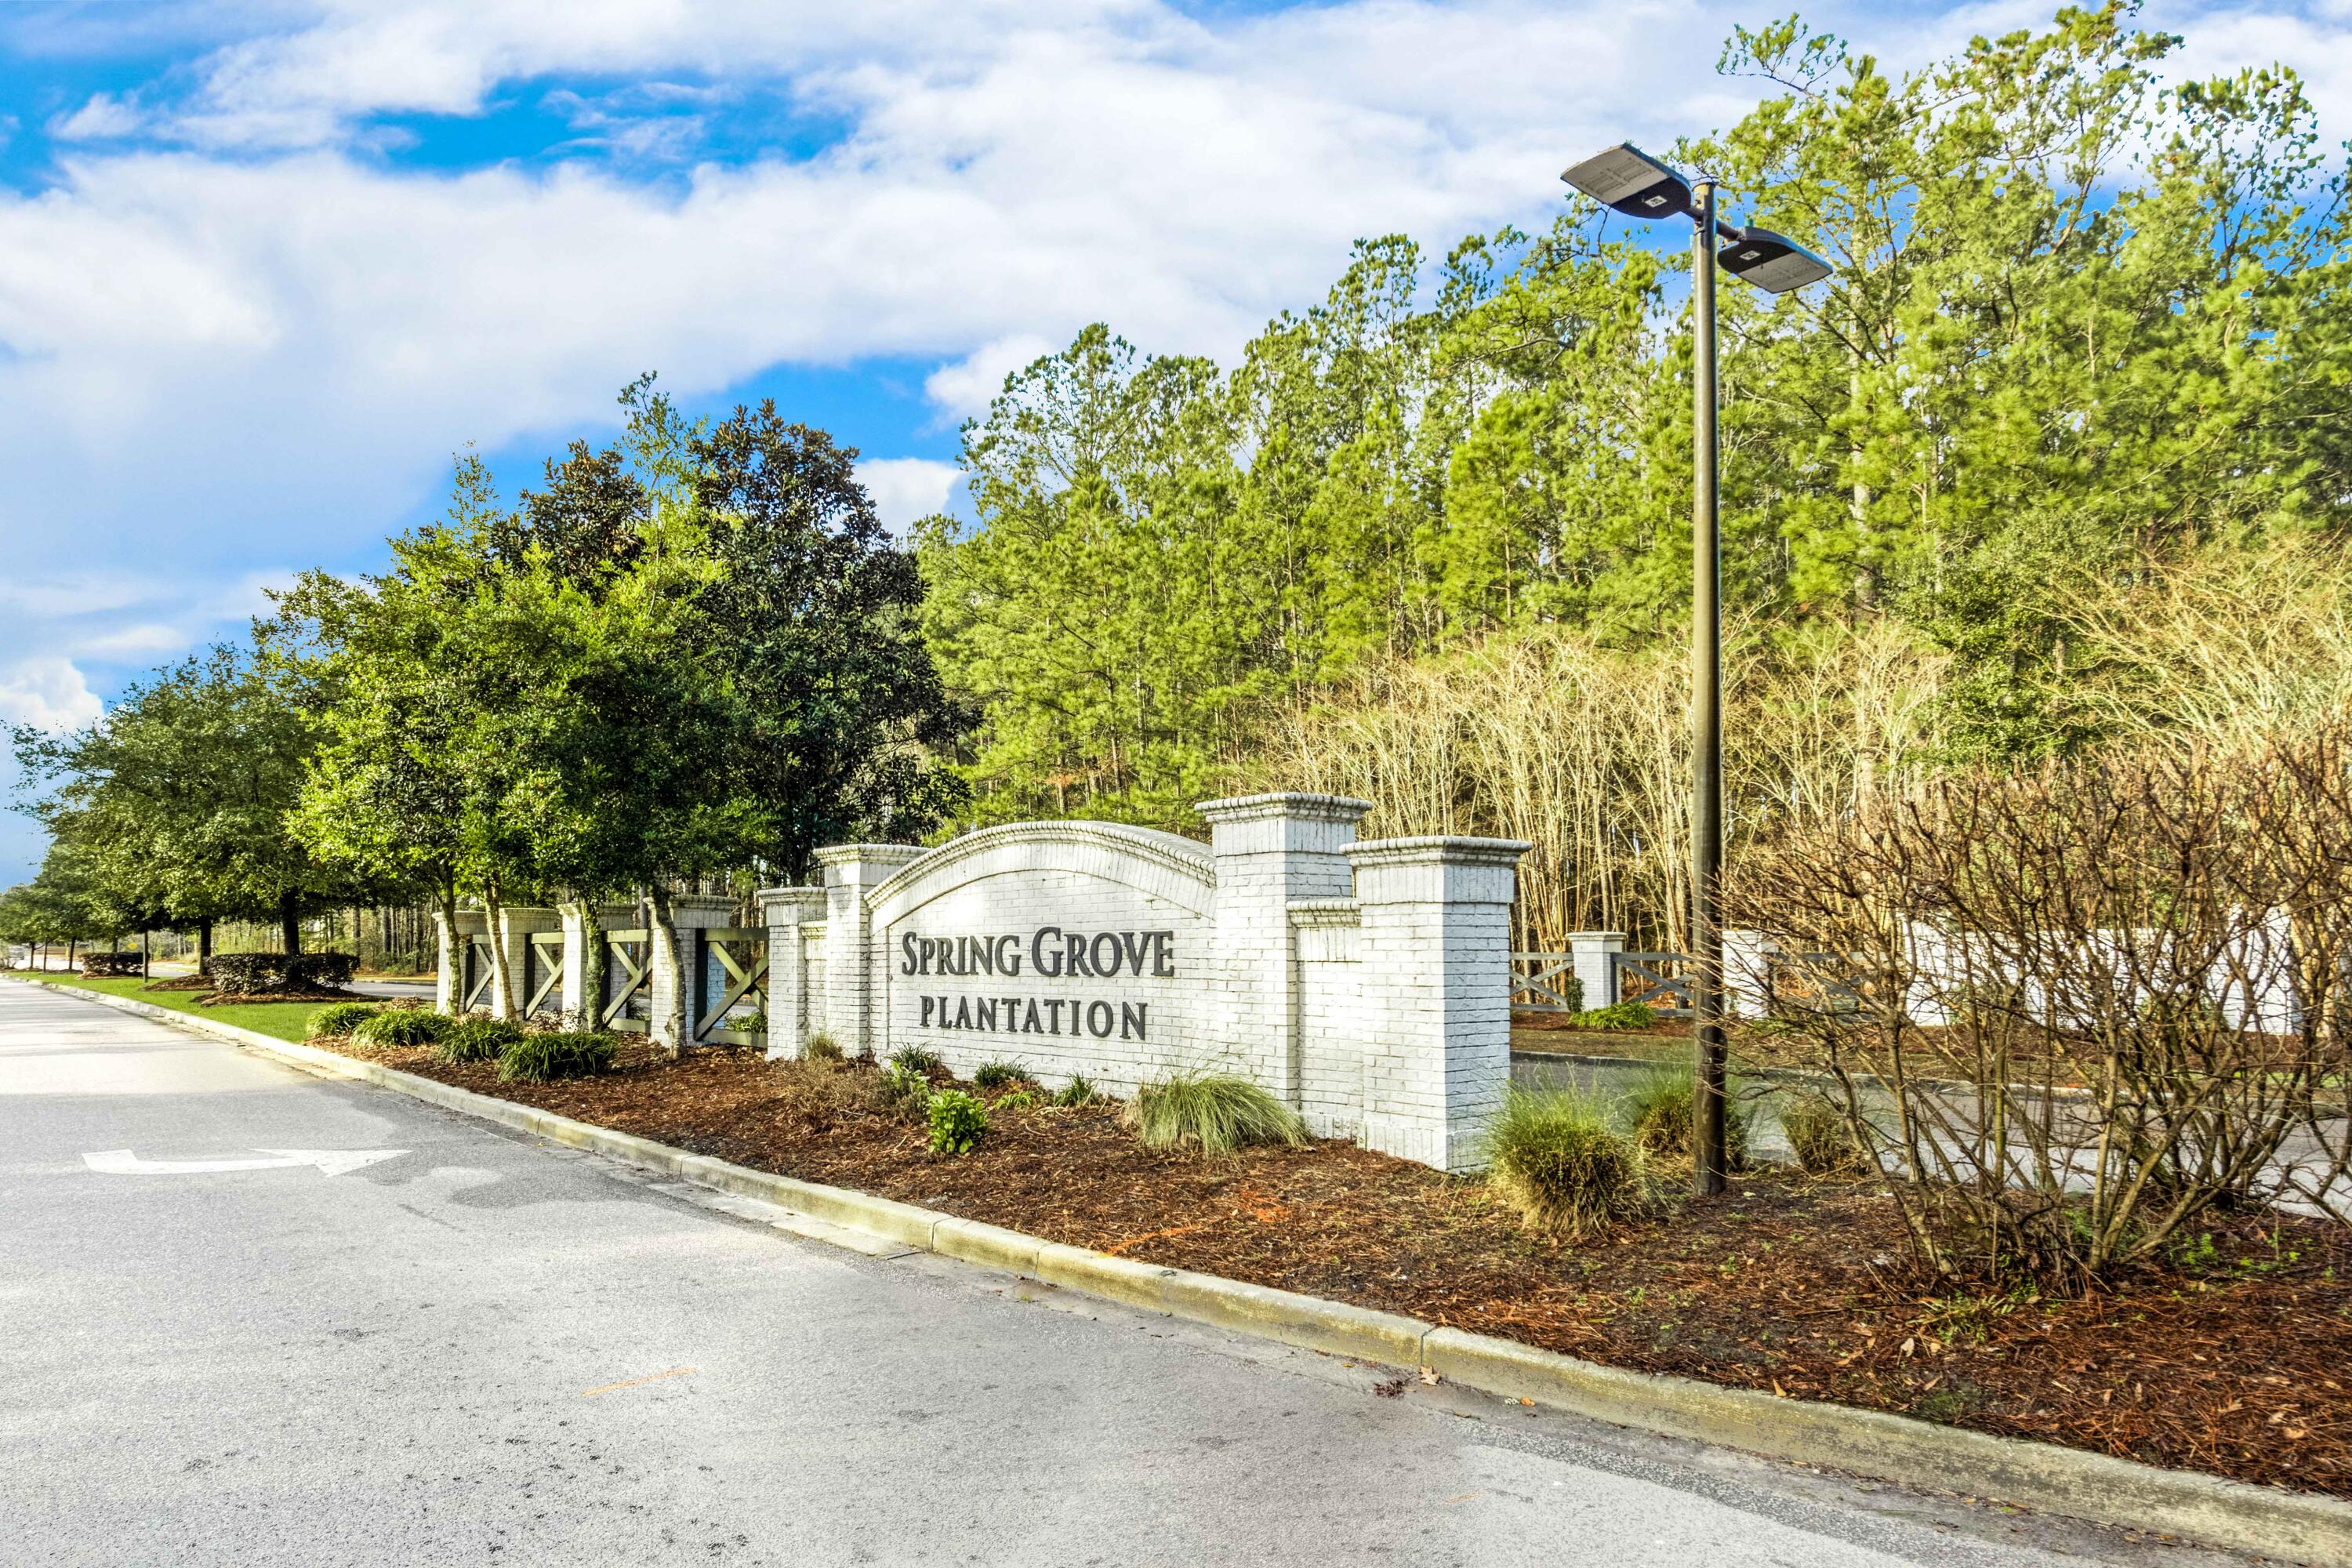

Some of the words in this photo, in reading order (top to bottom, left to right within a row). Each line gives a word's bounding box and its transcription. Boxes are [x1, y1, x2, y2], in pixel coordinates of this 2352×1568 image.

[902, 931, 1020, 976] SPRING
[1032, 927, 1174, 977] GROVE
[920, 996, 1147, 1040] PLANTATION
